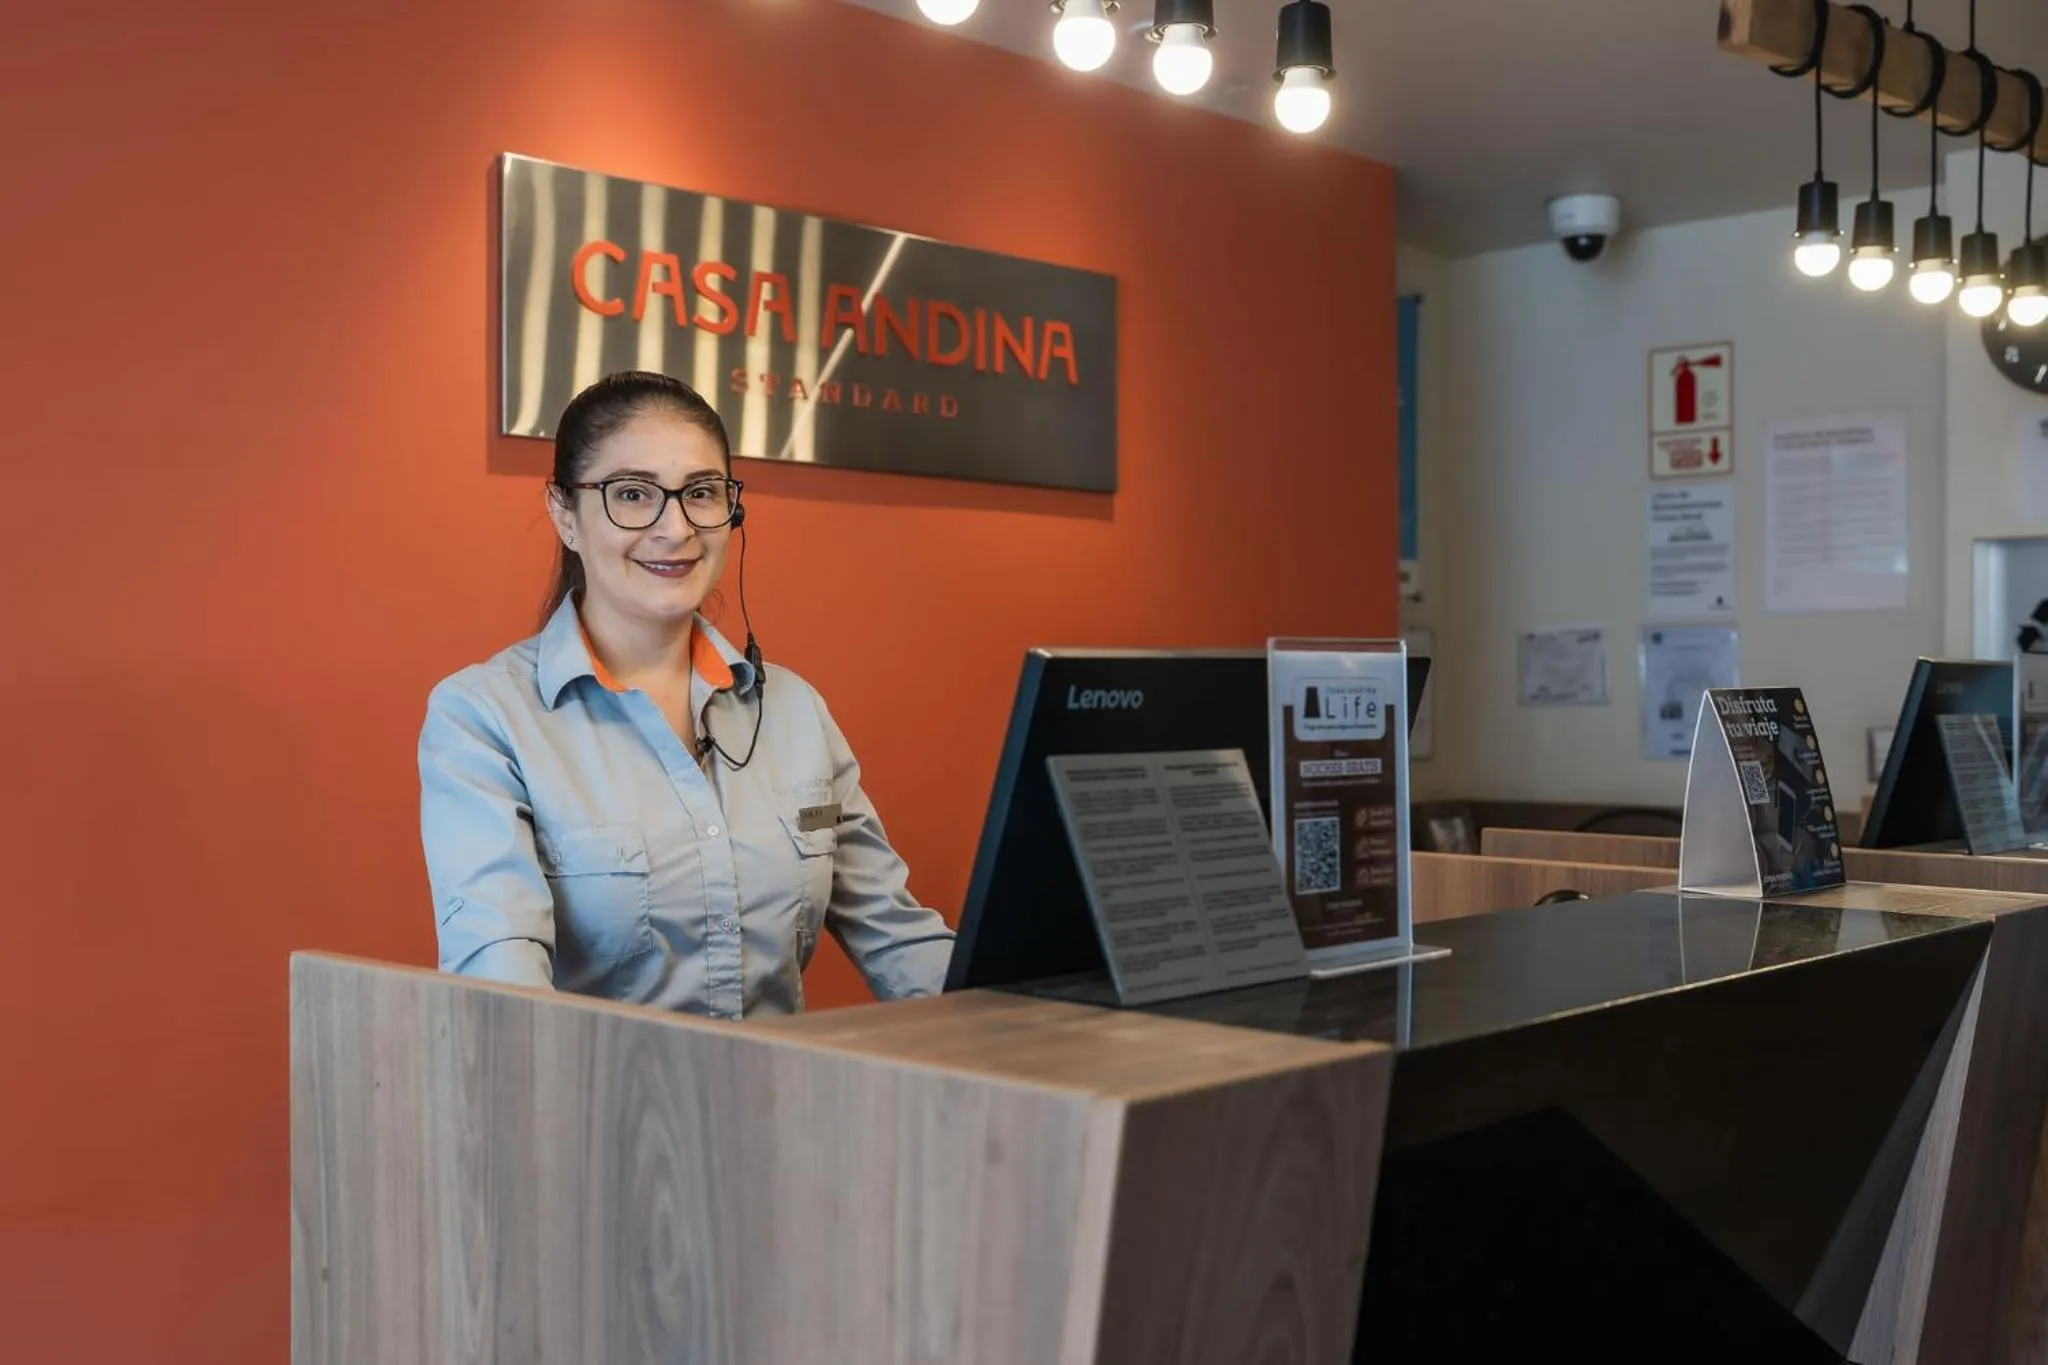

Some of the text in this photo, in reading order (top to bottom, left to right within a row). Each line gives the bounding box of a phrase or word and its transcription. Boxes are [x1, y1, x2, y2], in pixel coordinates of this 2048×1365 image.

[571, 240, 1078, 385] CASA ANDINA
[730, 368, 960, 421] STANDARD
[1066, 684, 1144, 710] Lenovo
[1325, 696, 1377, 719] Life
[1717, 696, 1778, 715] Disfruta
[1726, 721, 1742, 738] tu
[1744, 718, 1780, 742] viaje
